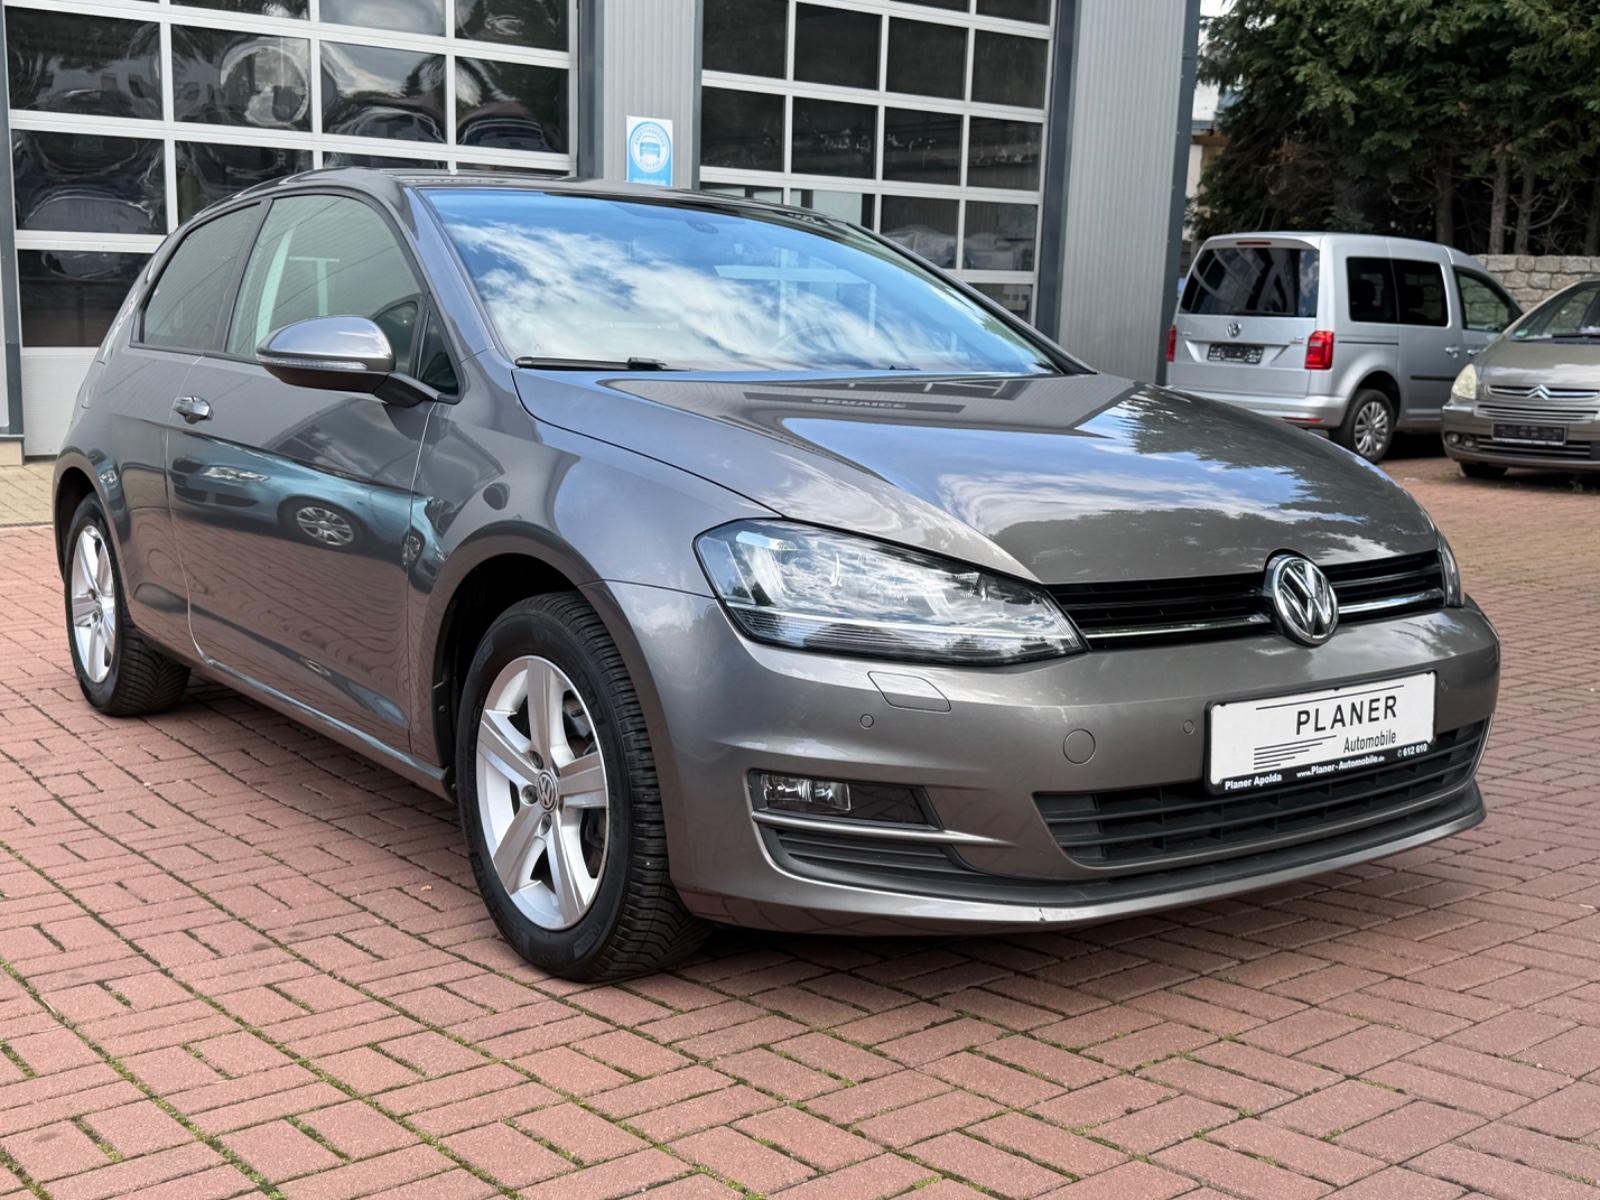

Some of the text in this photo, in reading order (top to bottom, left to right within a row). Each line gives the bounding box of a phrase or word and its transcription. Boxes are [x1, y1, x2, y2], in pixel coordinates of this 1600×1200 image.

[1296, 695, 1397, 735] PLANER
[1343, 729, 1397, 753] Automobile
[1225, 779, 1252, 790] Planer
[1253, 773, 1282, 786] Apolda
